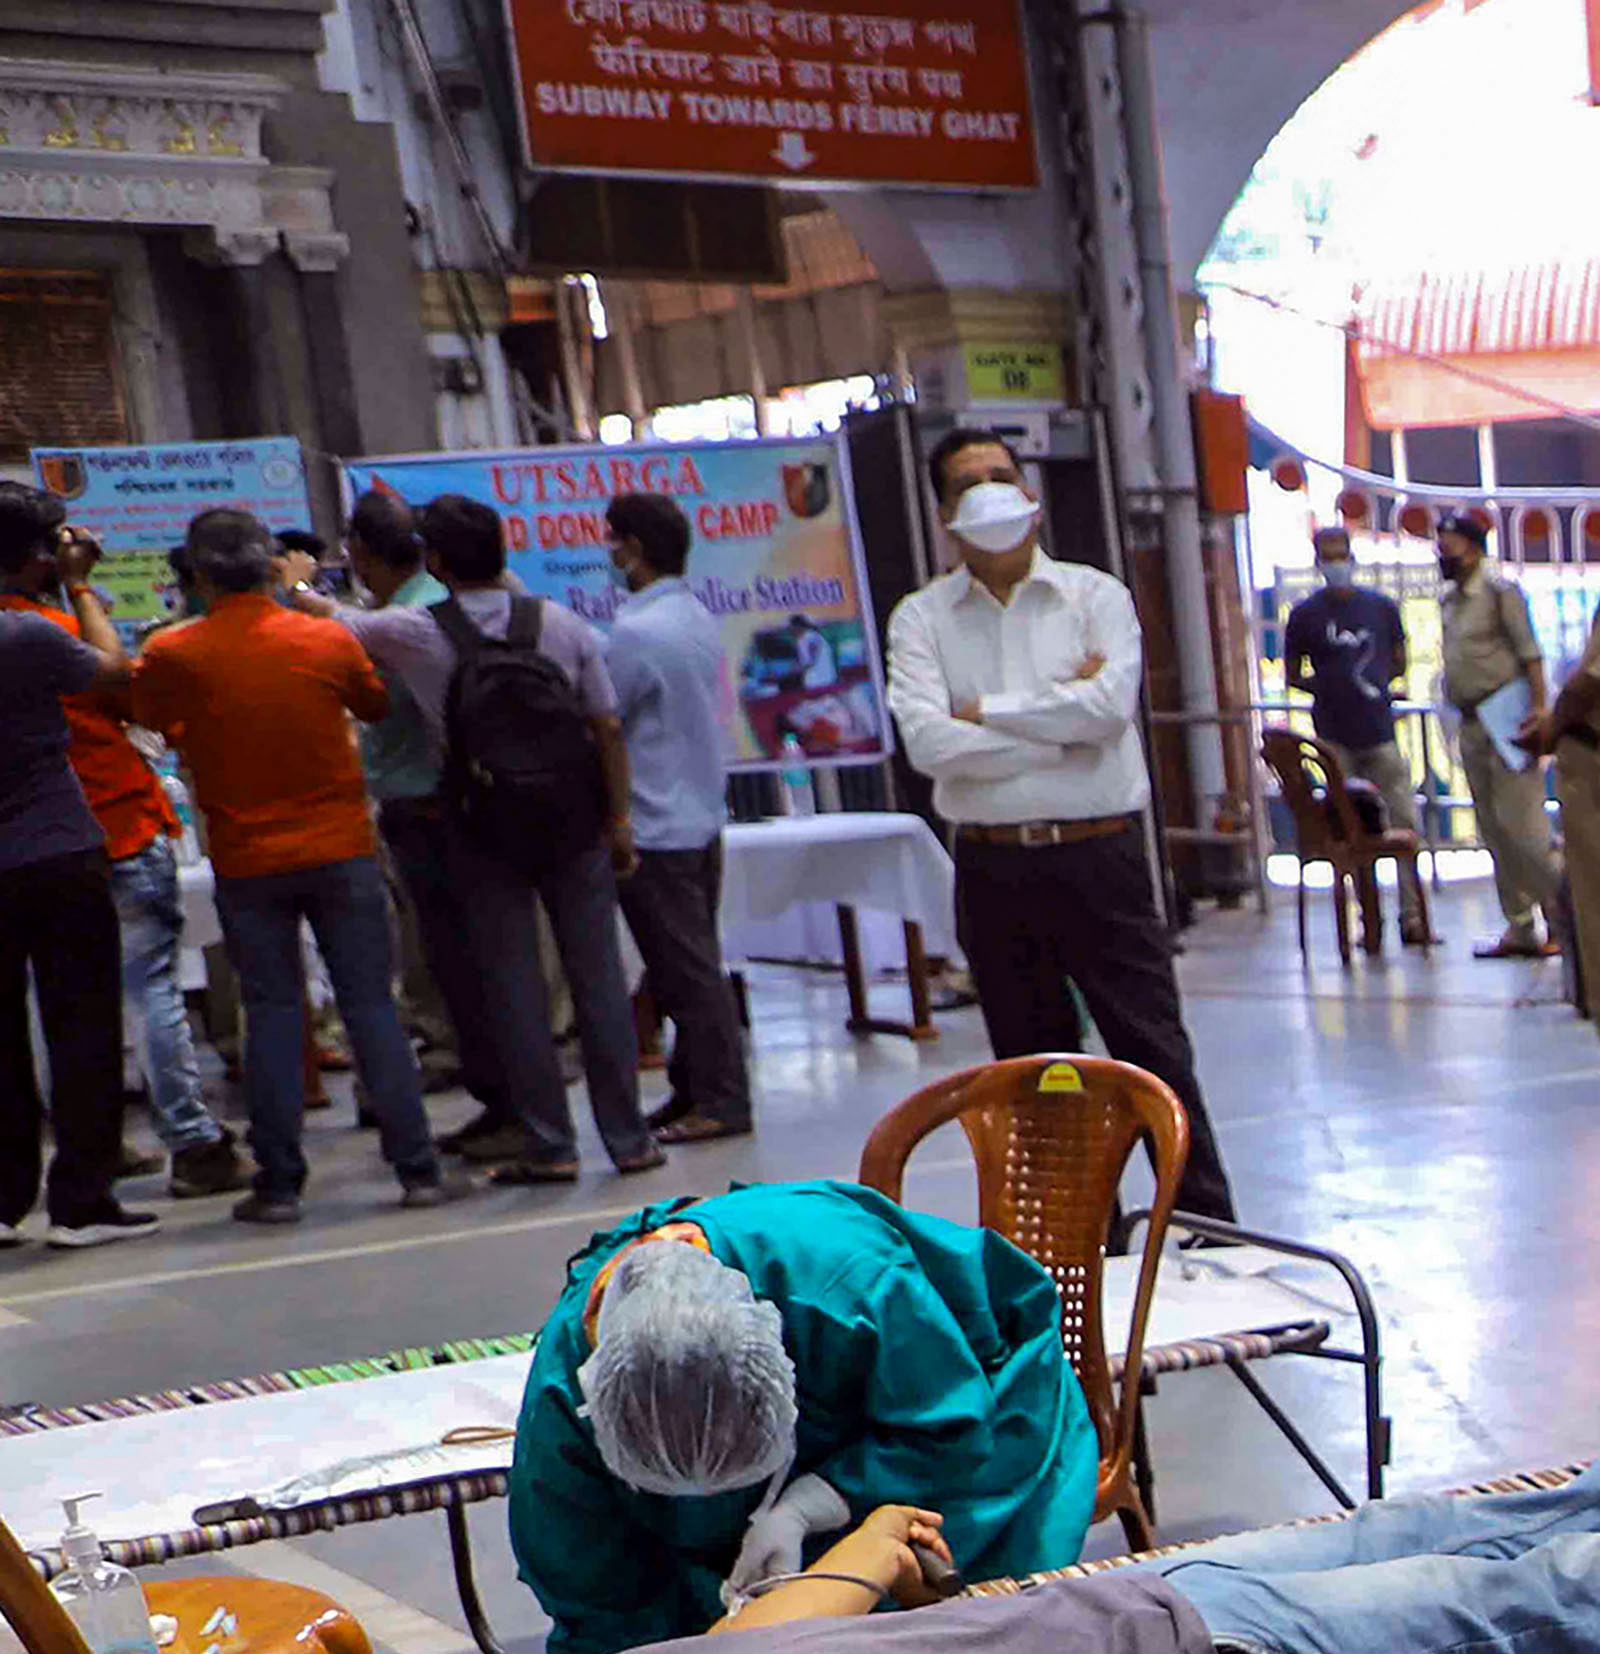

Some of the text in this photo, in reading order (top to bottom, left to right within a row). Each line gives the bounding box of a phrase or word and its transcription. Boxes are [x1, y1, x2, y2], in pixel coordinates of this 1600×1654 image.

[536, 83, 1020, 142] SUBWAY TOWARDS FERRY GHAT
[490, 456, 705, 503] UTSARGA
[697, 501, 781, 541] CAMP
[756, 575, 846, 608] Station
